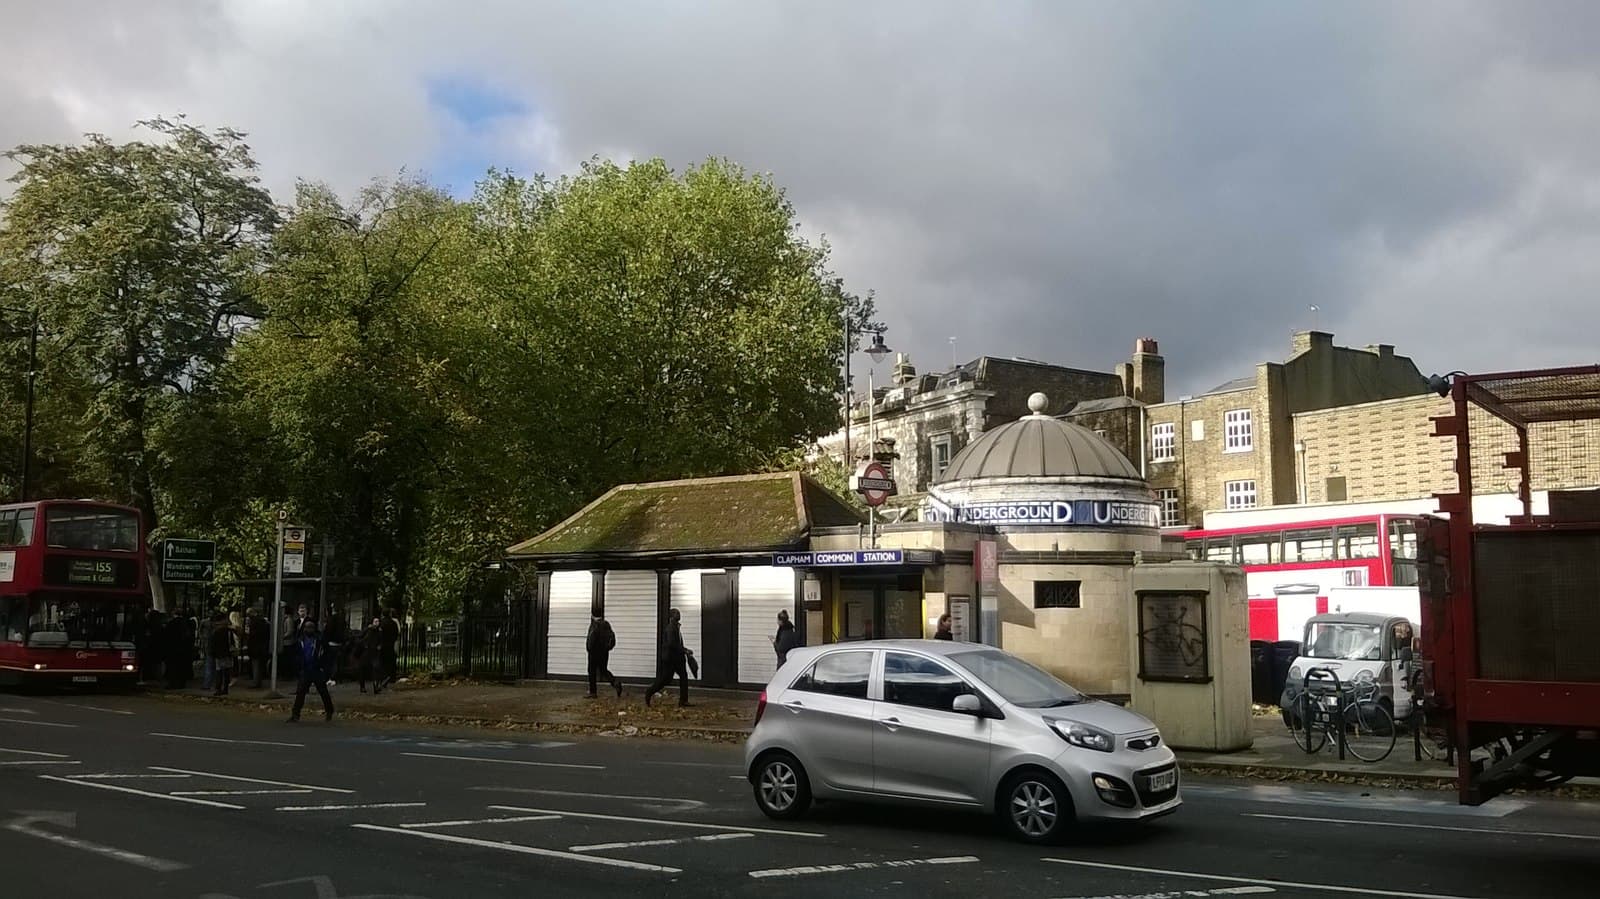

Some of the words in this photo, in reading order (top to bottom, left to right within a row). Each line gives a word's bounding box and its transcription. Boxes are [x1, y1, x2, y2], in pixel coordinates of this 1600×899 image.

[279, 510, 287, 520] D
[776, 554, 811, 564] CLAPHAM
[817, 552, 854, 564] COMMON
[863, 551, 896, 562] STATION
[96, 562, 112, 573] 155
